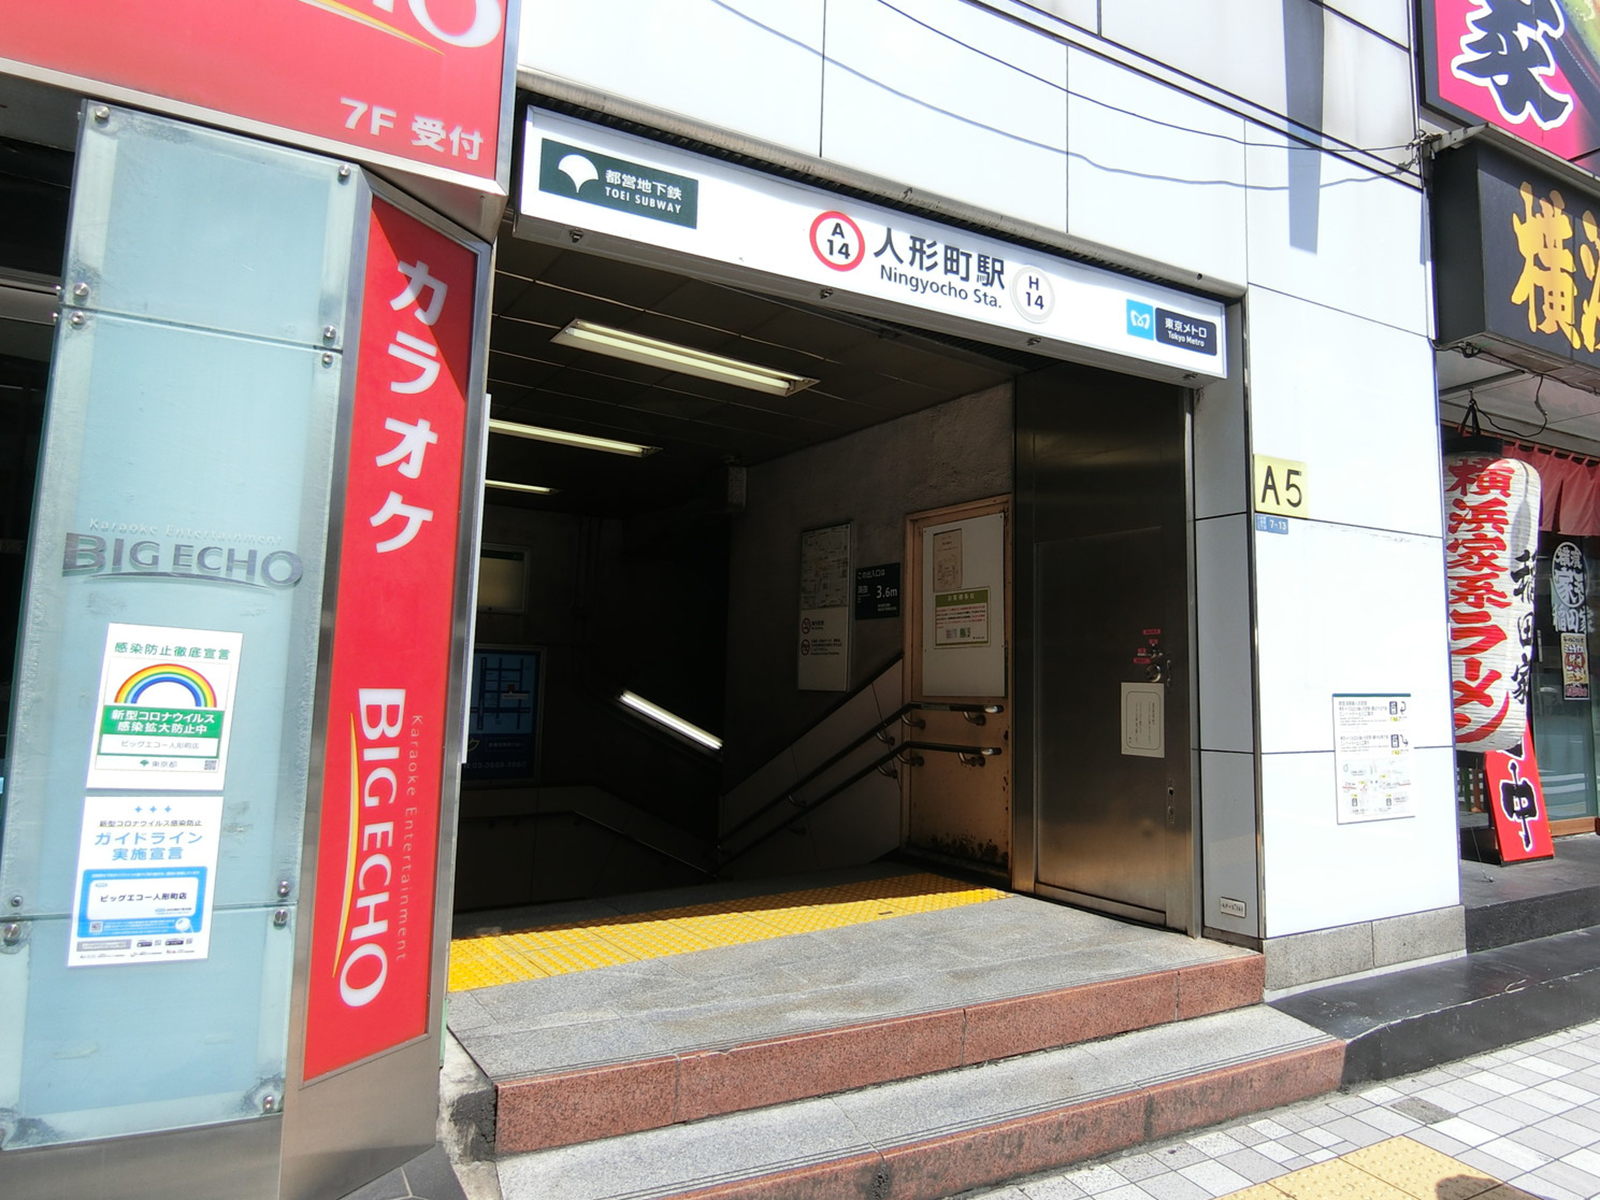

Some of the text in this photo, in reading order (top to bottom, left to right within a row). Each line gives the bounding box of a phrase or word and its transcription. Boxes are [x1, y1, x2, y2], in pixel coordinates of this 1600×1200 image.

[340, 96, 483, 161] 7F 受付
[605, 169, 682, 201] 都営地下鉄
[604, 186, 682, 214] TOEI SUBWAY
[831, 222, 845, 239] A
[827, 239, 850, 260] 14
[873, 227, 1005, 290] 人形町駅
[880, 264, 1002, 309] Ningyocho Sta.
[1028, 275, 1040, 291] H
[1025, 292, 1045, 310] 14
[1164, 317, 1207, 339] 東京メトロ
[1167, 330, 1205, 348] Tokyo Metro
[369, 259, 448, 554] カラオケ
[1261, 465, 1303, 508] A5
[62, 532, 304, 588] BIG ECHO
[876, 584, 898, 599] 3.6m
[1447, 458, 1515, 744] 横浜家系ラーメン
[114, 642, 231, 660] 感染防止徹底宣言
[111, 709, 216, 724] 新型コロナウイルス
[117, 721, 207, 735] 感染拡大防止中
[94, 831, 203, 846] ガイドライン
[340, 688, 406, 1008] BIG ECHO
[396, 714, 423, 962] Karaoke Entertainment
[112, 847, 184, 861] 実施宣言
[100, 892, 188, 903] ビッグエコー人形町店
